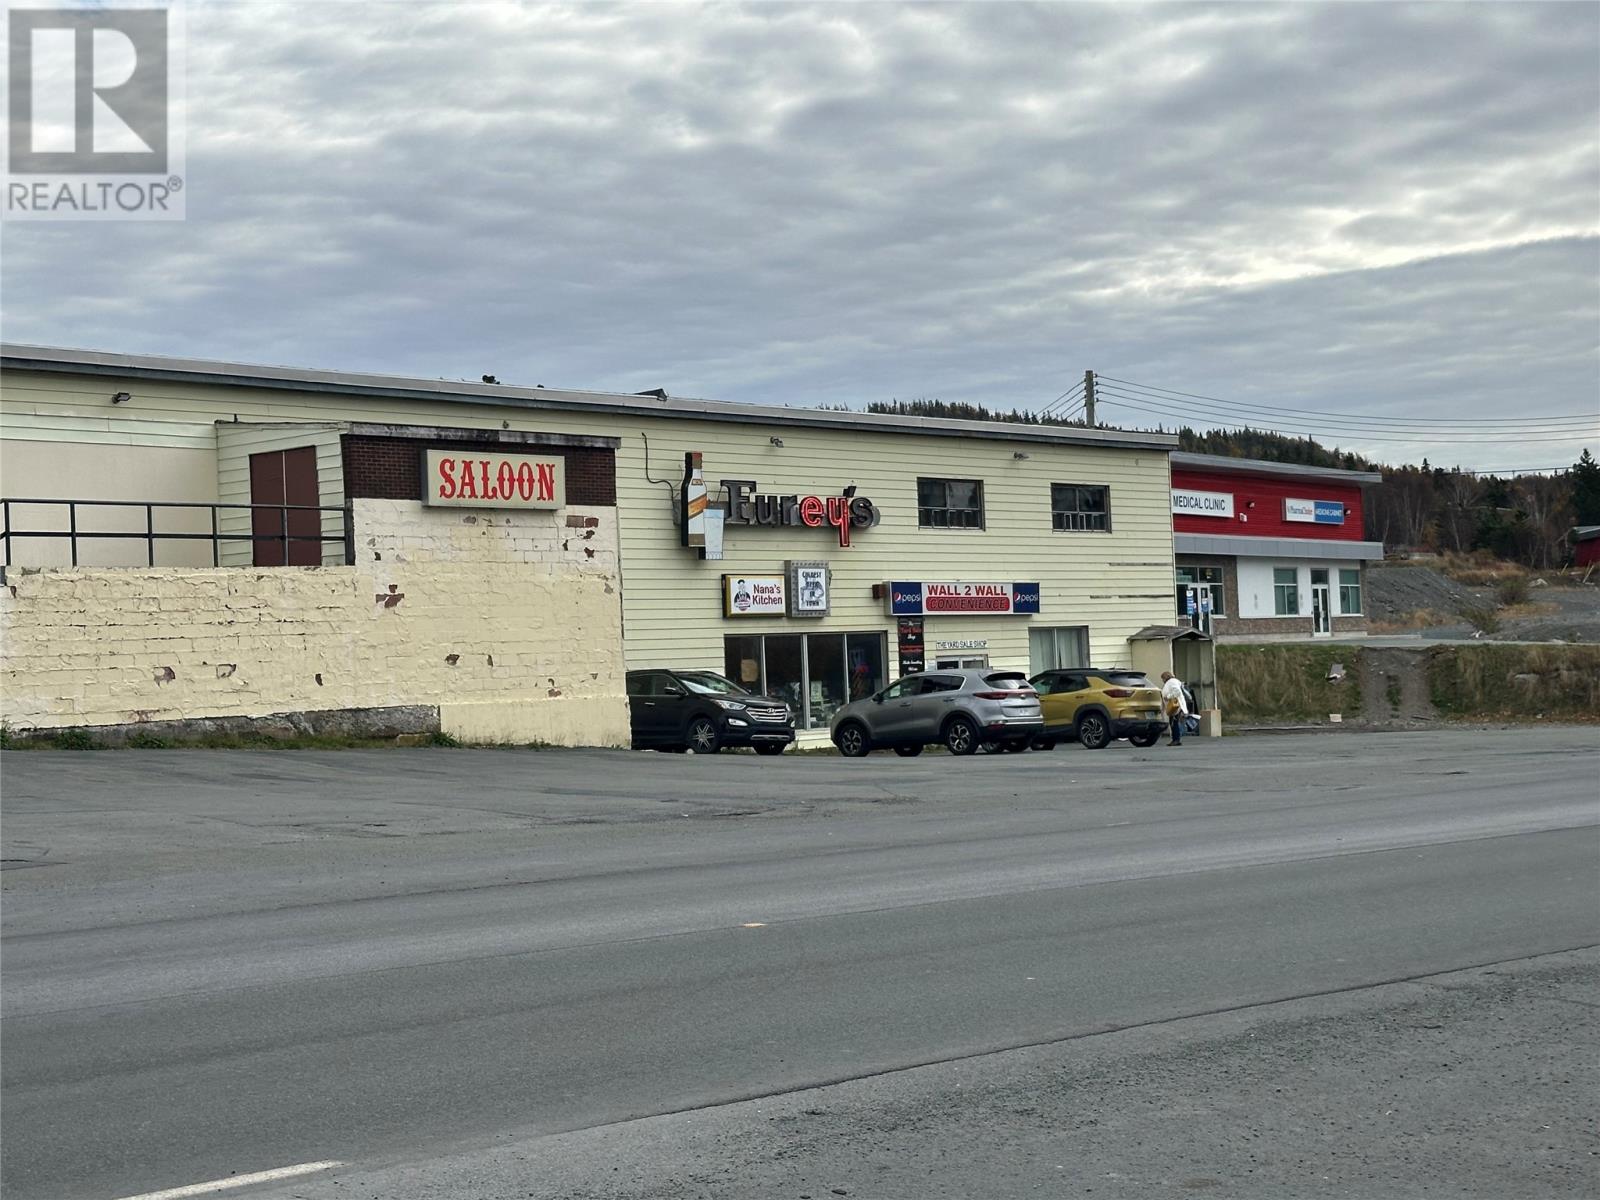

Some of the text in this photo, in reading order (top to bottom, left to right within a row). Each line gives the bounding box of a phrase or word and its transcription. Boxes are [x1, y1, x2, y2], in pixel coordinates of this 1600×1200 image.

[439, 458, 555, 501] SALOON
[1173, 495, 1226, 511] MEDICAL CLINIC
[720, 480, 873, 547] Furey's
[753, 584, 781, 594] Nana's
[928, 585, 1007, 596] WALL 2 WALL
[752, 594, 783, 606] Kitchen
[902, 592, 921, 603] pepsi
[1021, 592, 1039, 603] pepsi
[930, 598, 1006, 610] CONVENIENCE
